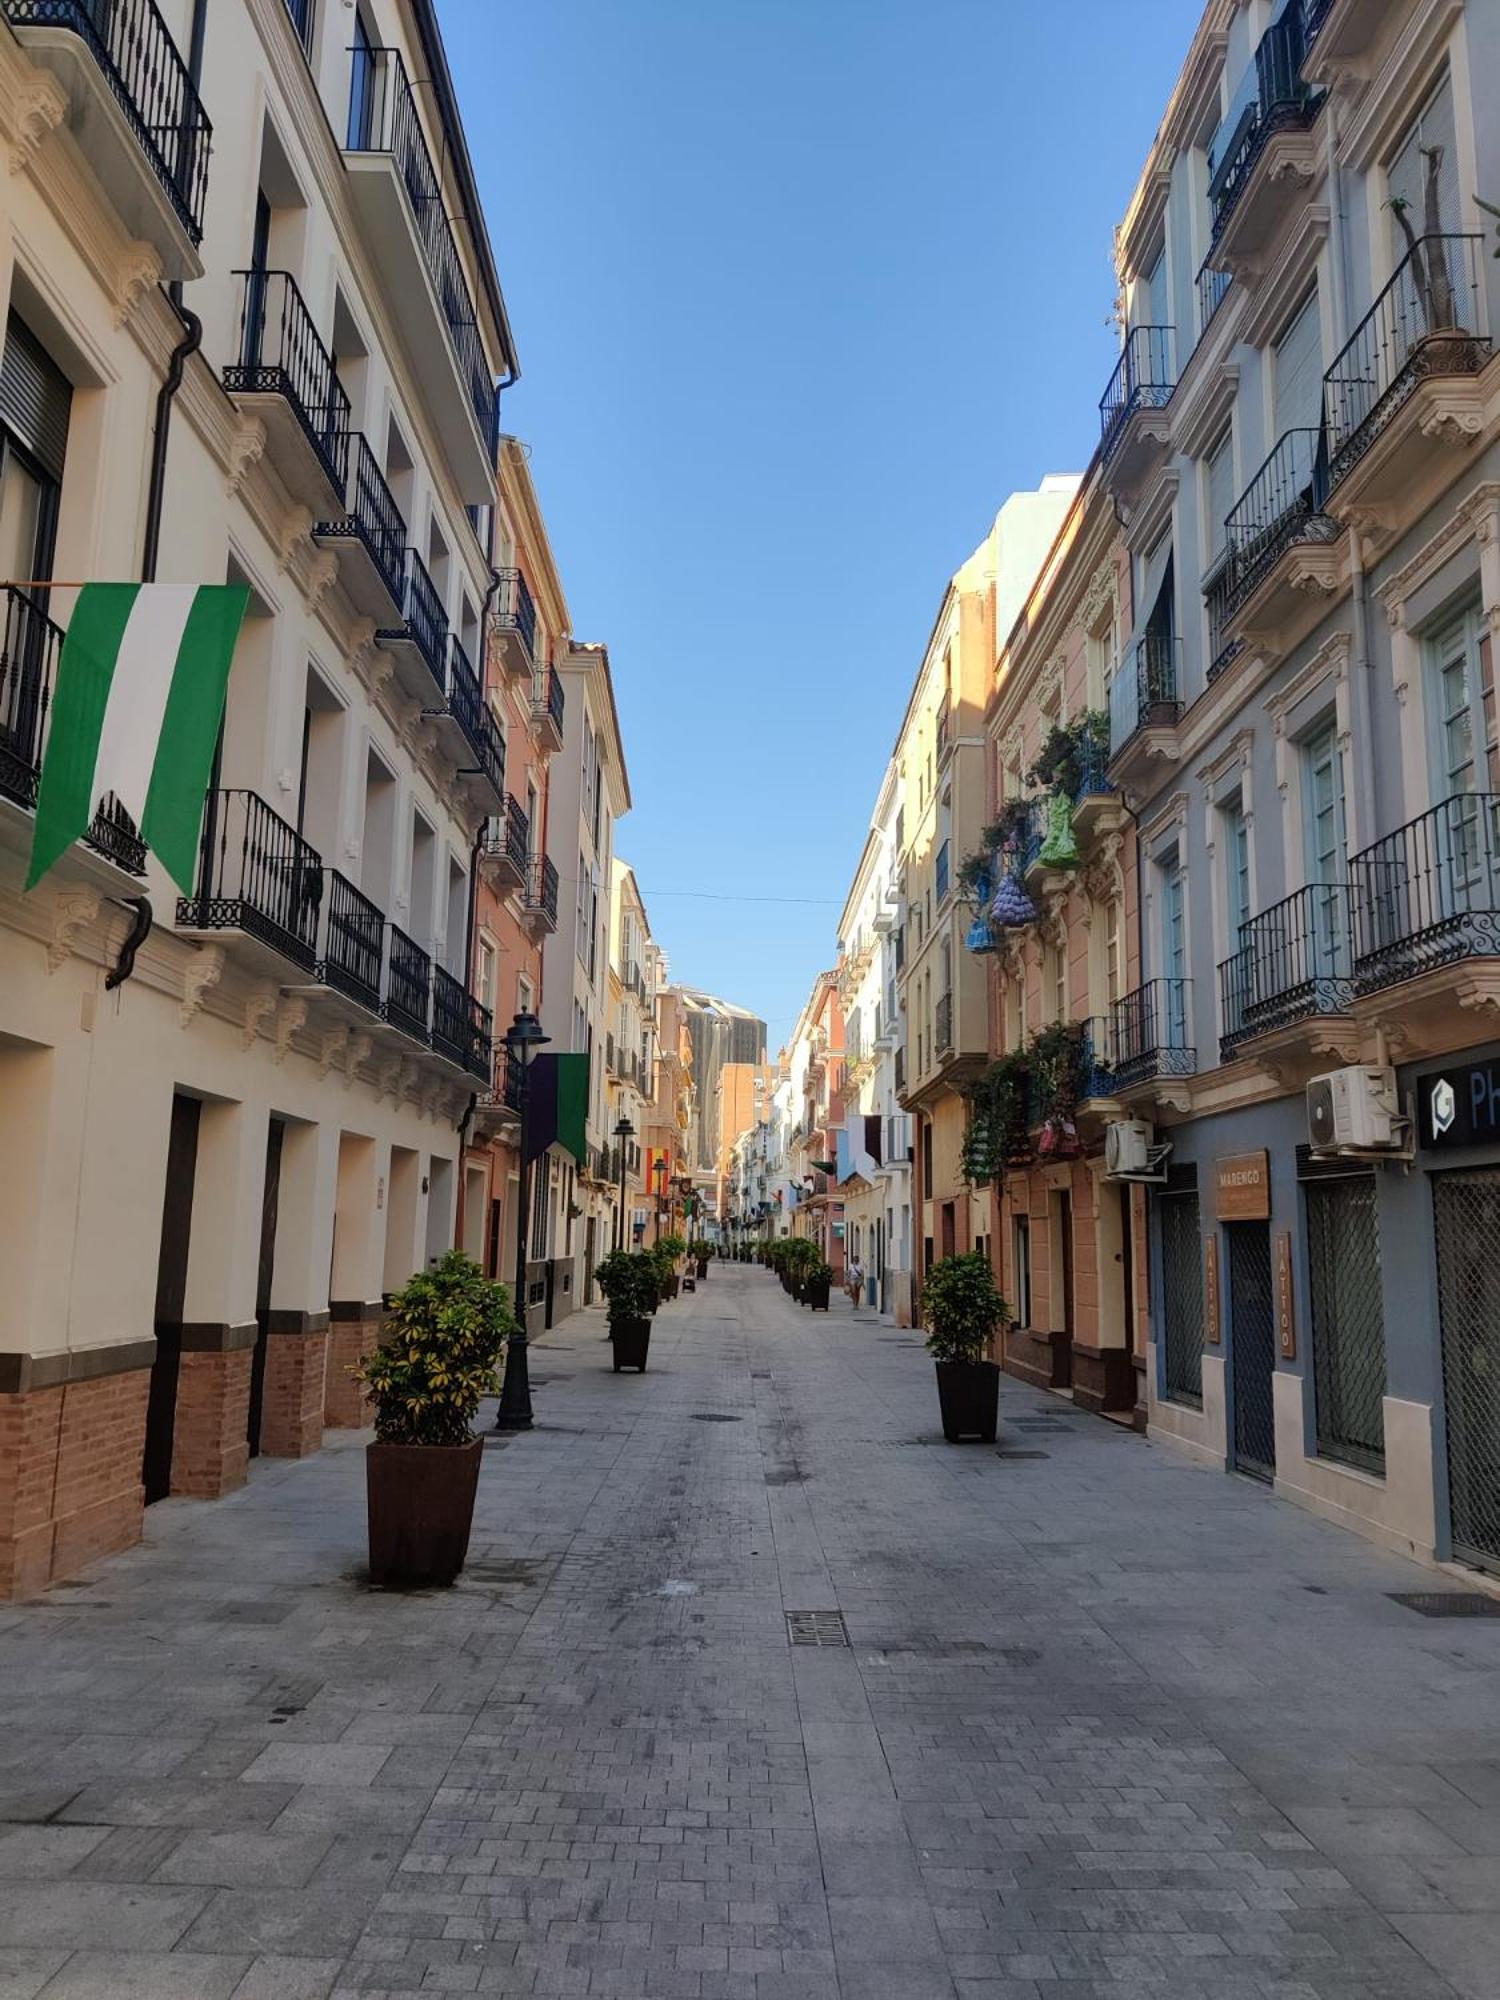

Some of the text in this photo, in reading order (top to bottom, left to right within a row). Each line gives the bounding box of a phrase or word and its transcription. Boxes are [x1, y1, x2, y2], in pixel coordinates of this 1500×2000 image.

[1219, 1169, 1260, 1187] MARENGO
[1207, 1239, 1216, 1333] TATTOO
[1279, 1239, 1289, 1347] TATTOO
